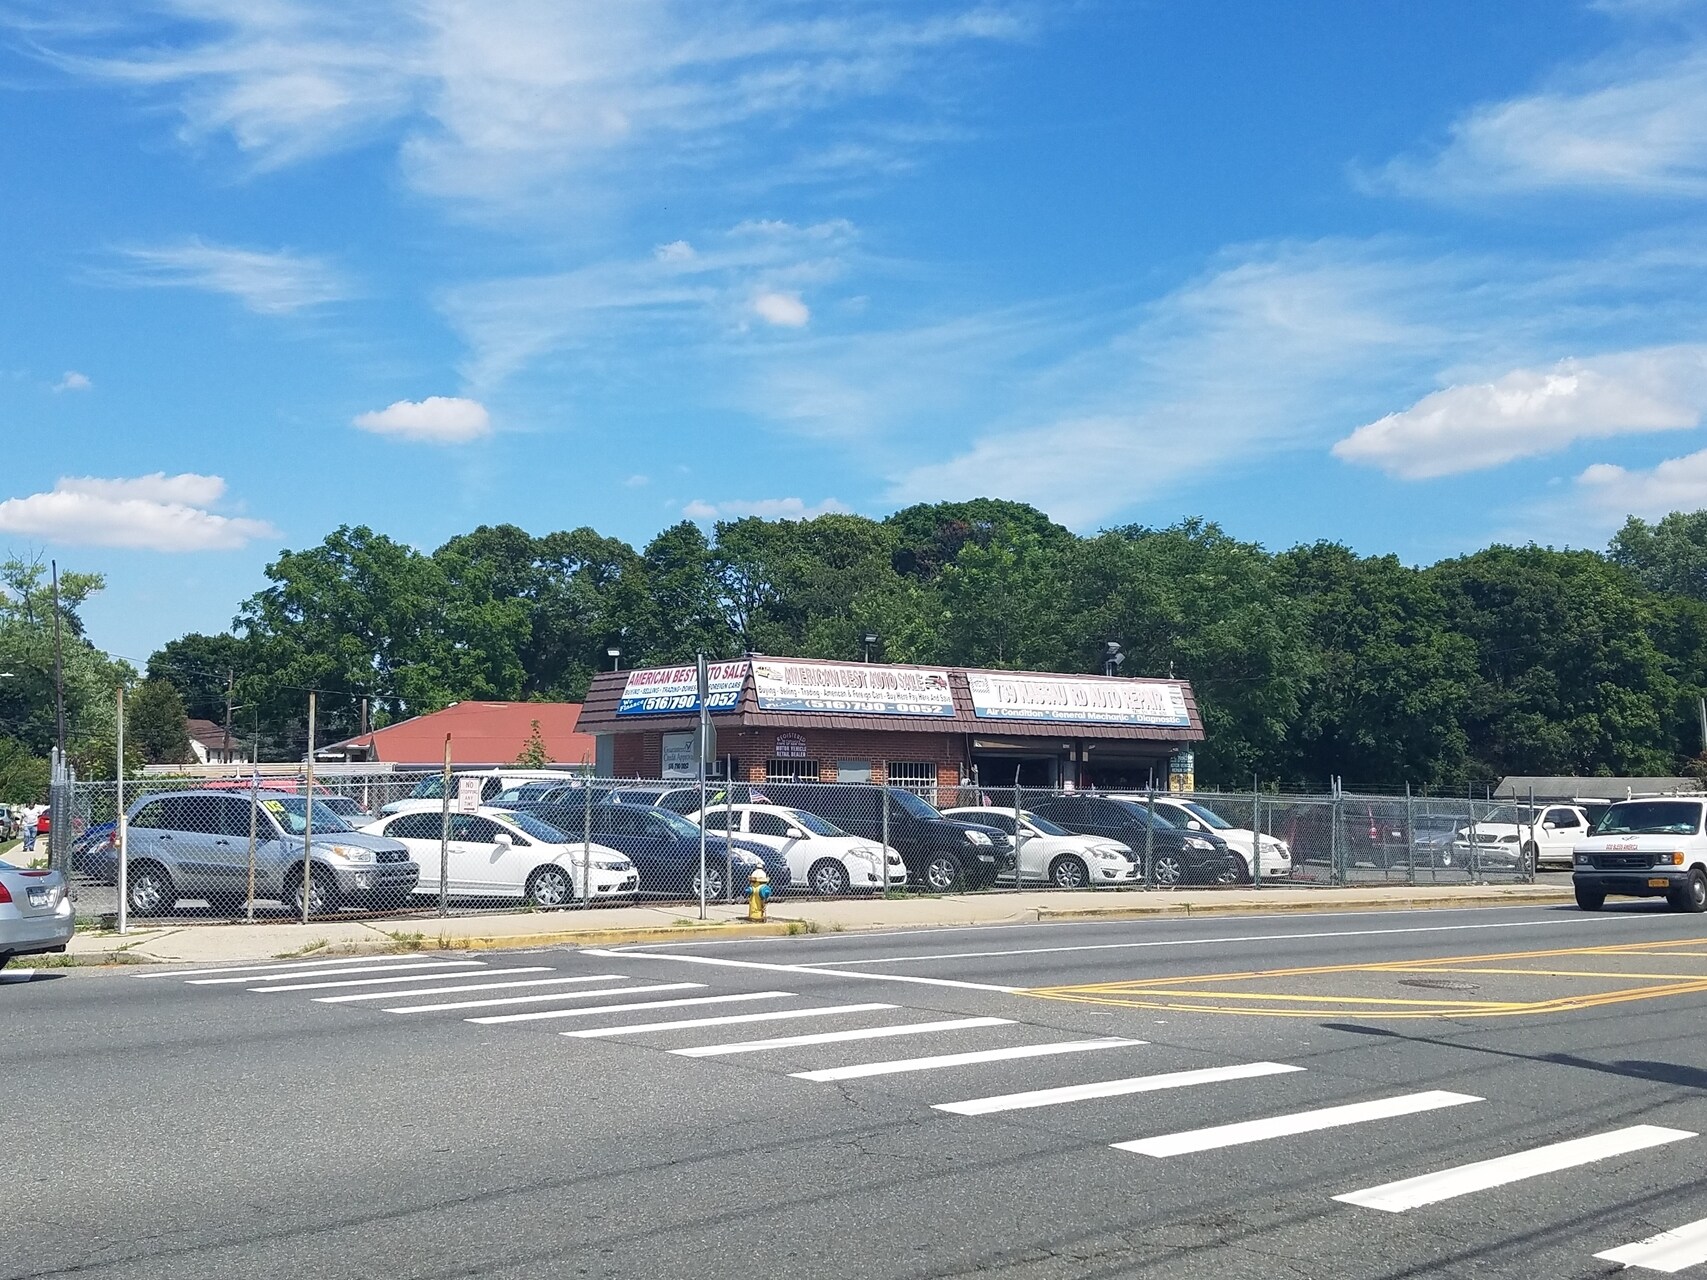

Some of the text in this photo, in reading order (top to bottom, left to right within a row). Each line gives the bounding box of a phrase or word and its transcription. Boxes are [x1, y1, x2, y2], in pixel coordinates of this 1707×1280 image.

[628, 669, 673, 686] AMERICAN
[672, 668, 697, 684] BEST
[722, 663, 748, 680] SALE
[784, 666, 926, 691] AMERICAN BEST AUTO SALE
[728, 681, 742, 689] CARS
[985, 708, 1000, 716] Air
[1000, 708, 1044, 717] Condition
[1051, 710, 1086, 719] General
[1087, 712, 1129, 722] Mechanic
[1136, 714, 1181, 724] Diagnostic
[465, 781, 474, 789] NO
